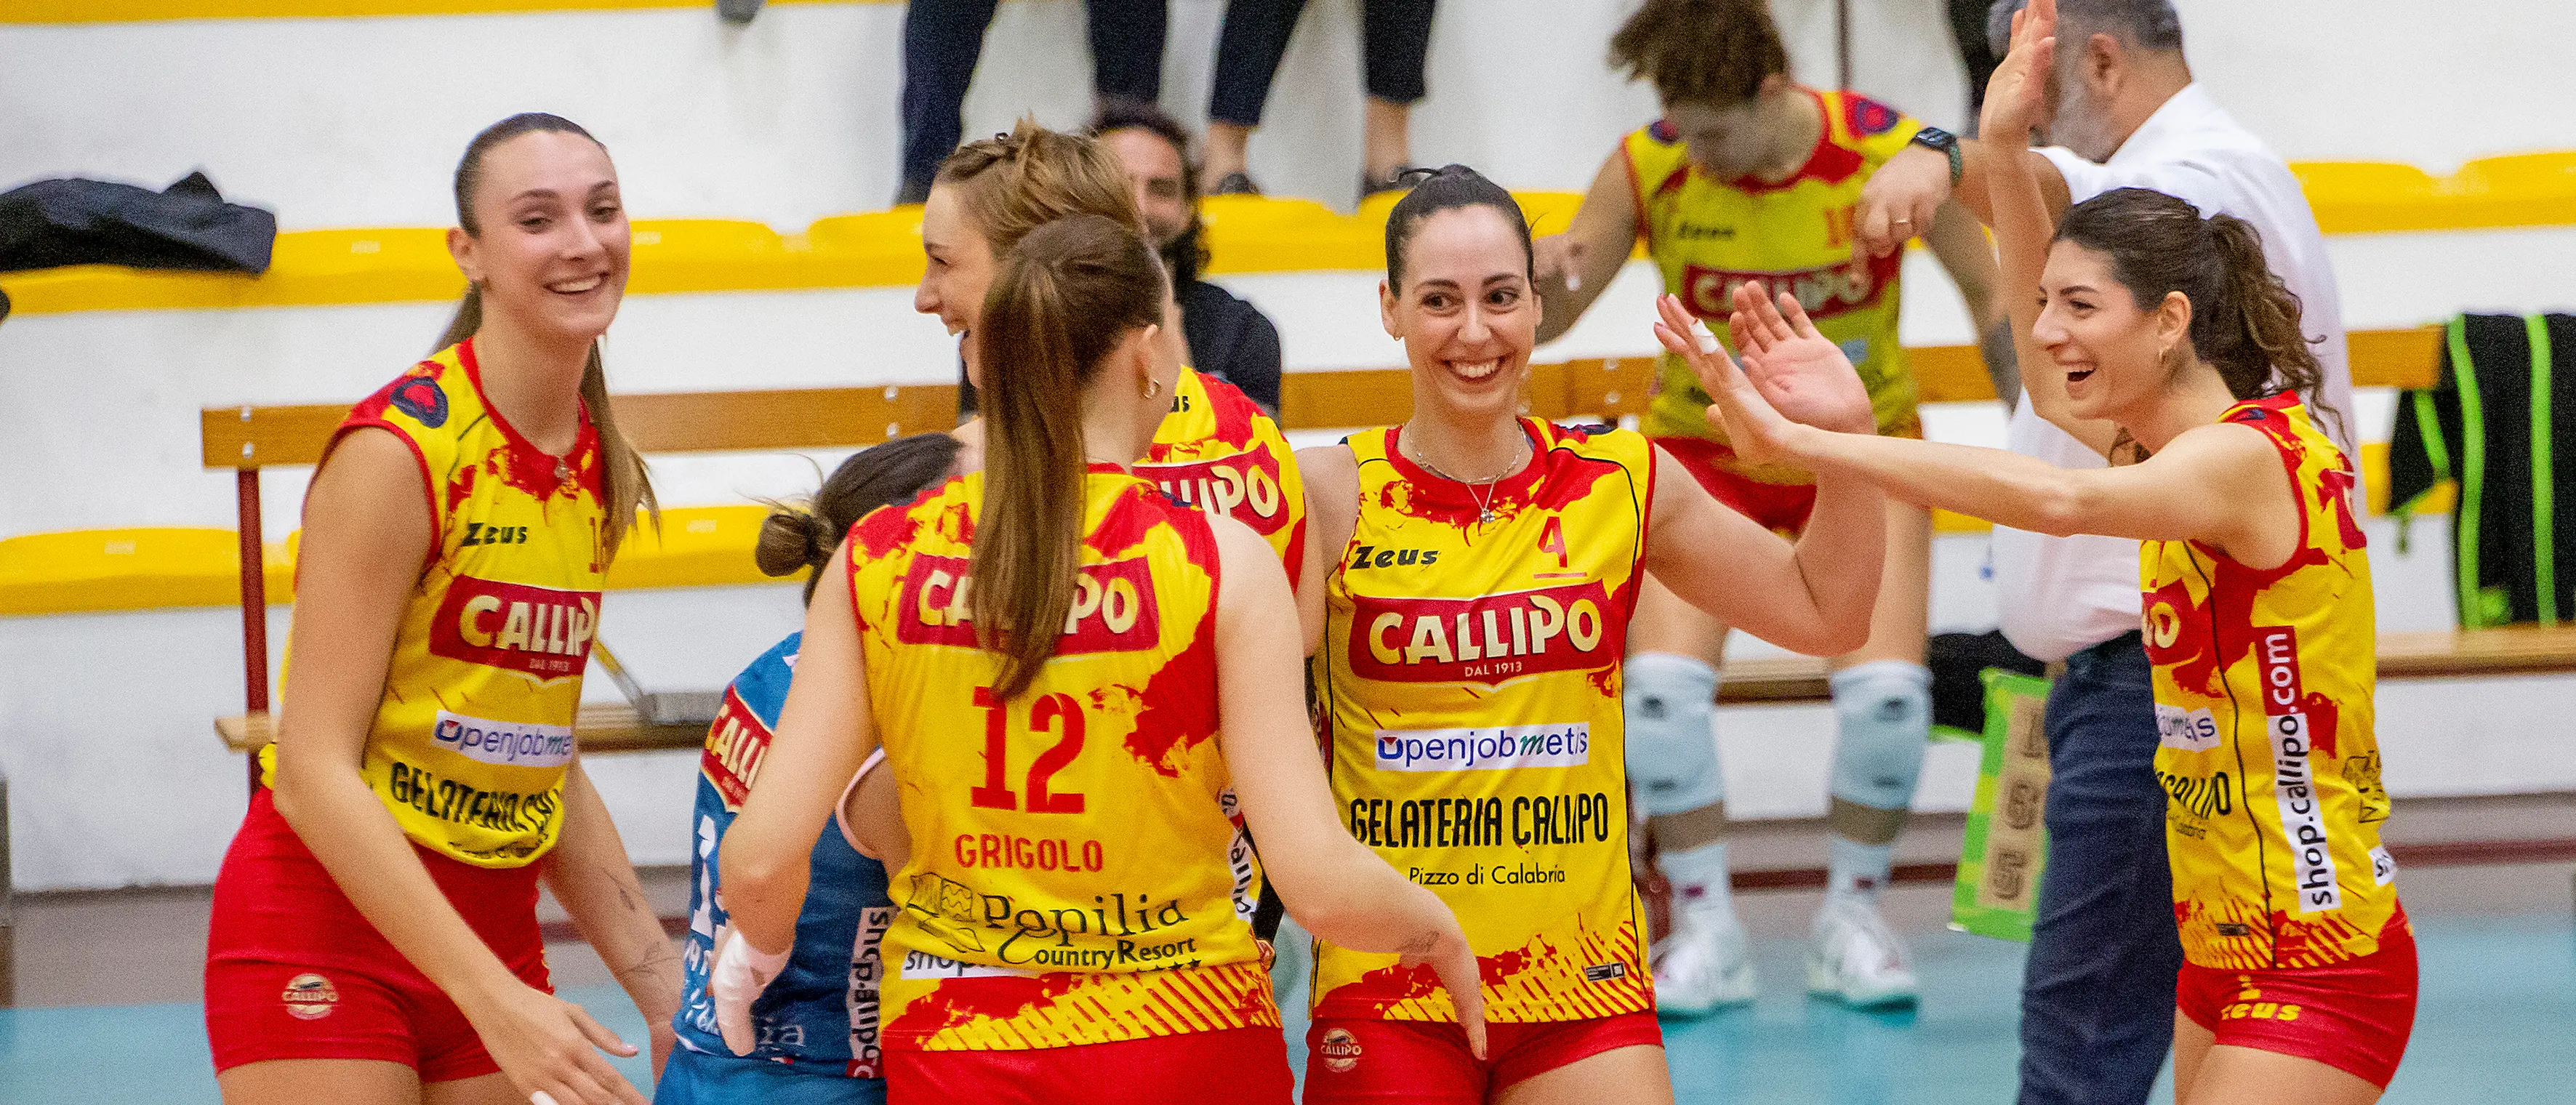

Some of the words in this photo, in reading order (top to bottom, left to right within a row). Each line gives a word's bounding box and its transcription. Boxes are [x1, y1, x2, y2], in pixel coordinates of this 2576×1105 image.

[461, 522, 529, 547] Zeus
[1537, 515, 1568, 568] 4
[1349, 545, 1440, 570] Zeus
[1368, 594, 1602, 665] CALLIPO
[1464, 664, 1490, 678] DAL
[1494, 661, 1522, 675] 1913
[971, 686, 1086, 814] 12
[1378, 726, 1588, 768] Openjobmetis
[2264, 632, 2332, 906] shop.callipo.com
[1350, 797, 1503, 848] GELATERIA
[955, 834, 1104, 873] GRIGOLO
[1408, 866, 1459, 885] Pizzo
[1466, 862, 1484, 885] di
[1490, 864, 1565, 885] Calabria
[1320, 1043, 1363, 1056] CALLIPO
